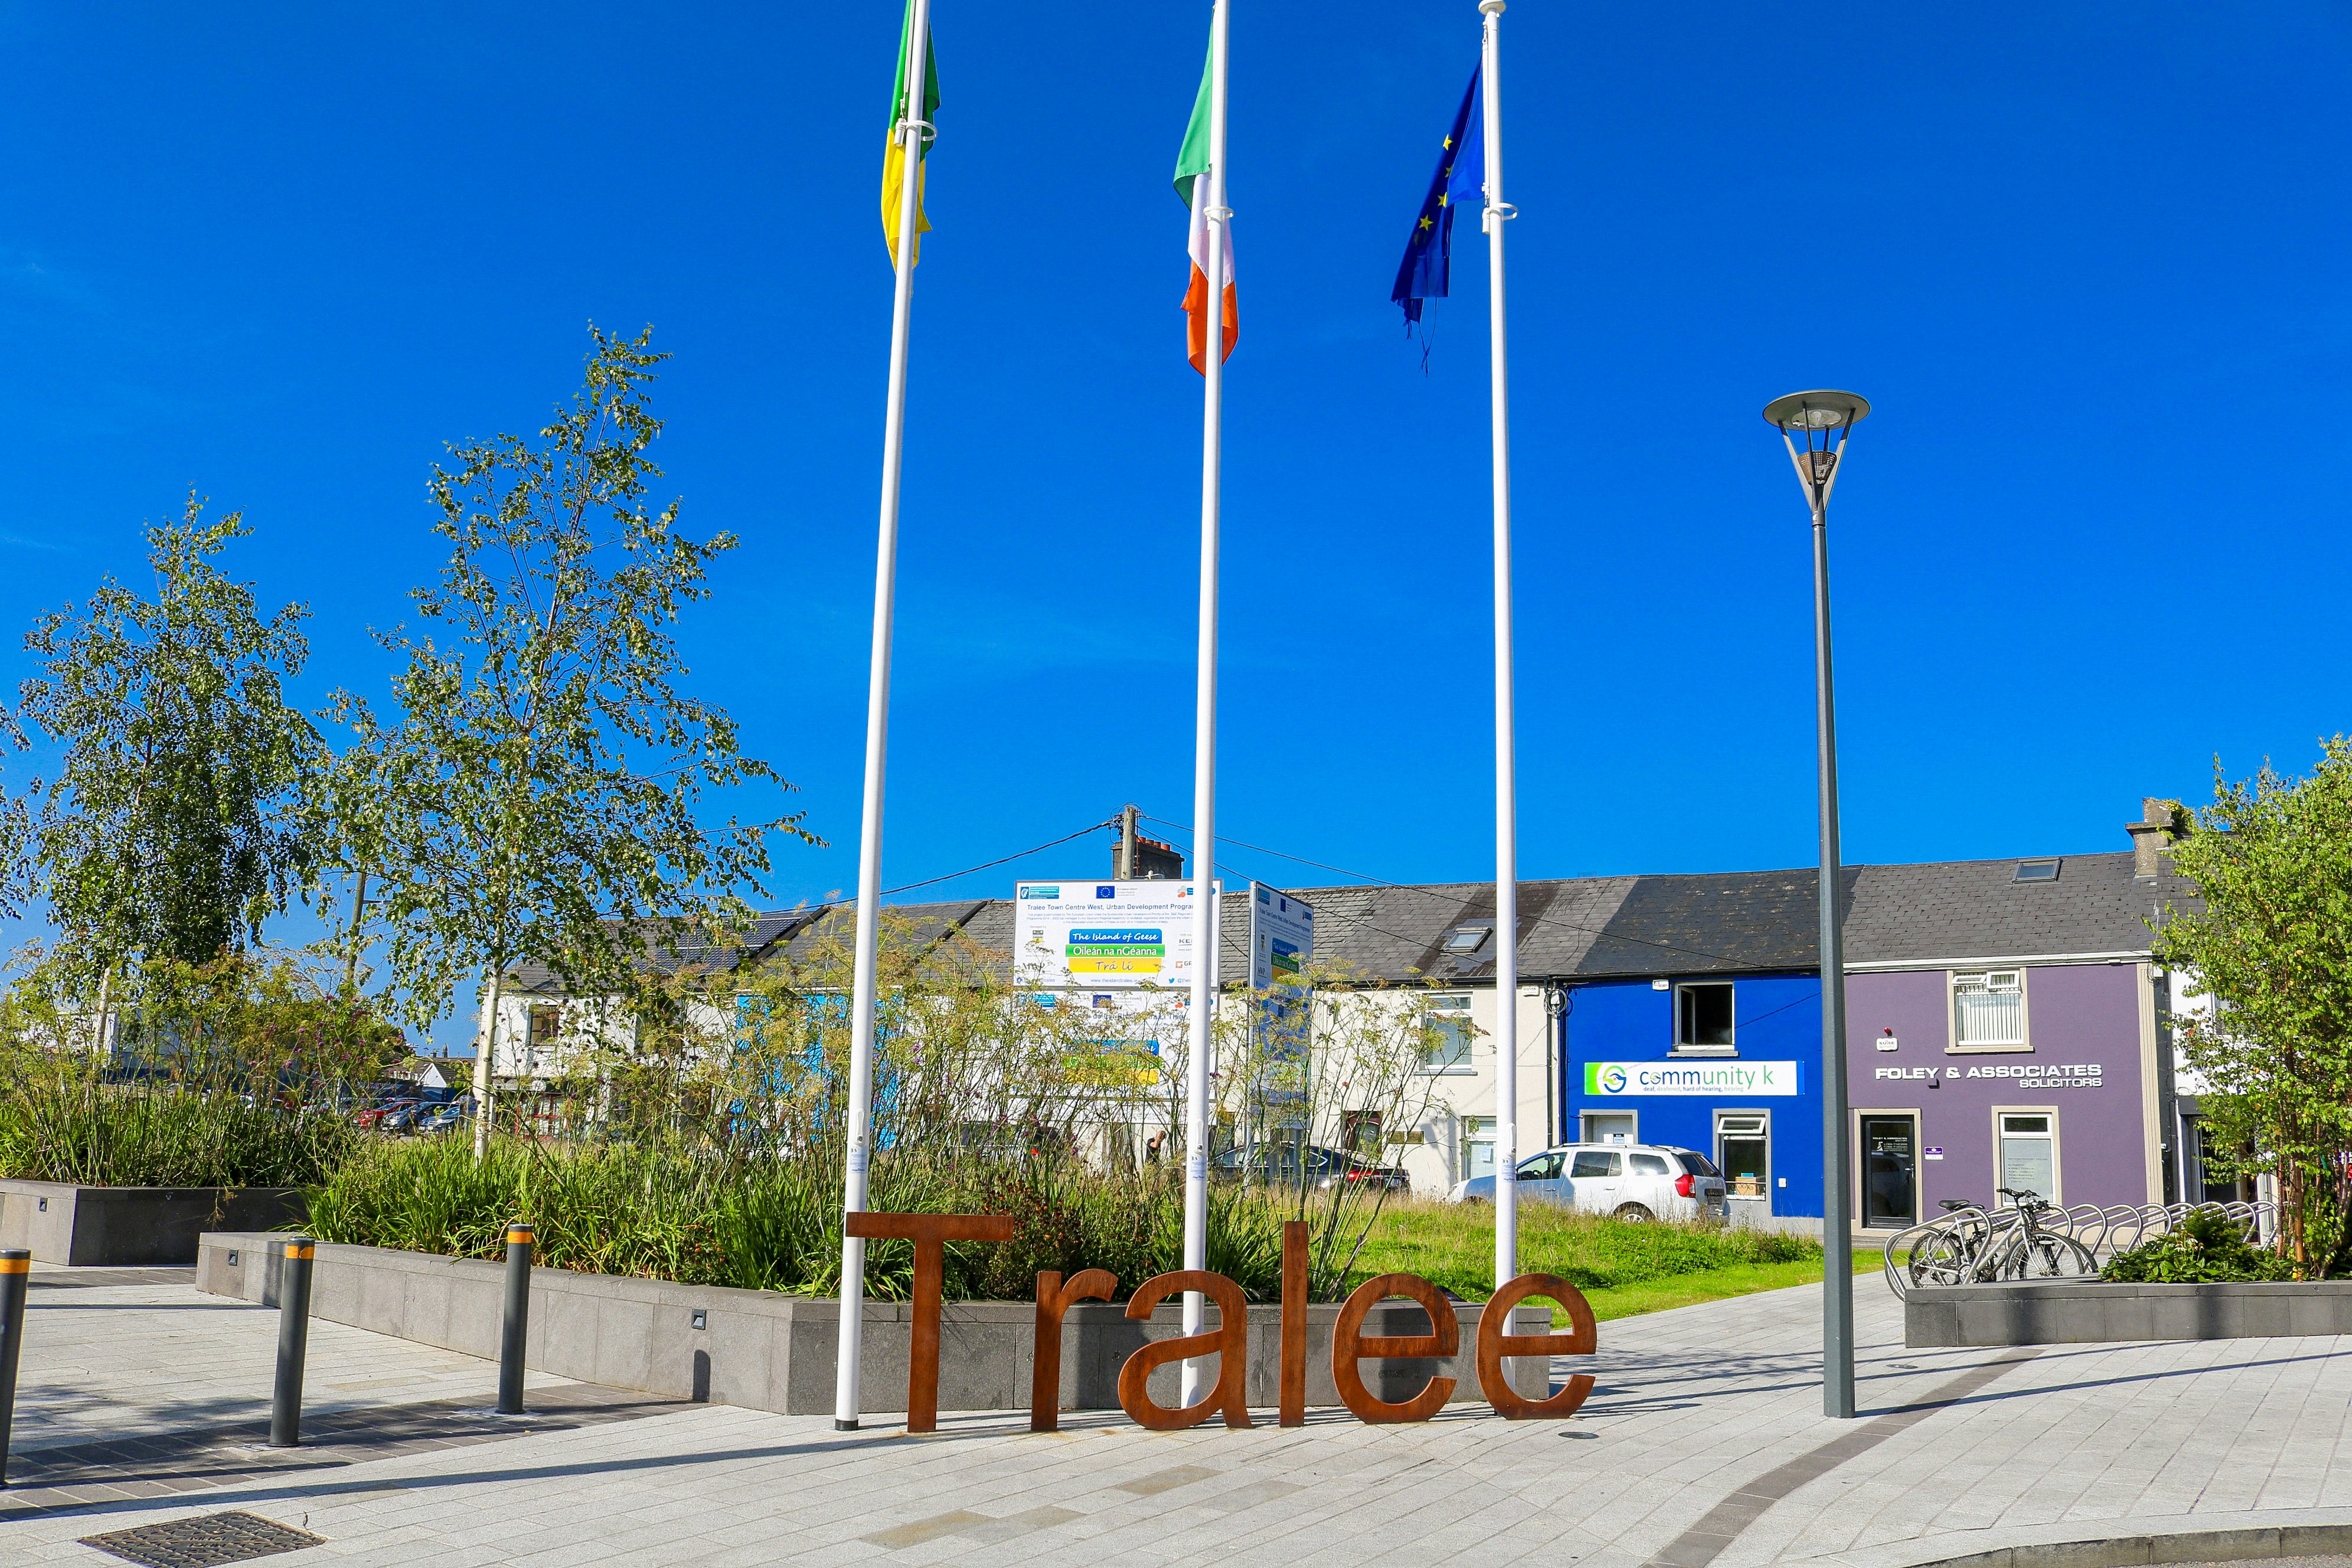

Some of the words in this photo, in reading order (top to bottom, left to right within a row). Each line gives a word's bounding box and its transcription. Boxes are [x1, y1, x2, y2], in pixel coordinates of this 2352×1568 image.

[1123, 933, 1133, 942] of
[1073, 946, 1102, 955] Oileán
[1116, 946, 1157, 956] nGéanna
[1095, 961, 1118, 971] Trá
[1763, 1064, 1774, 1085] k
[1875, 1066, 1939, 1080] FOLEY
[1945, 1066, 1961, 1079] &
[1966, 1064, 2102, 1079] ASSOCIATES
[2019, 1078, 2102, 1088] SOLICITORS
[846, 1211, 1598, 1433] Tralee
